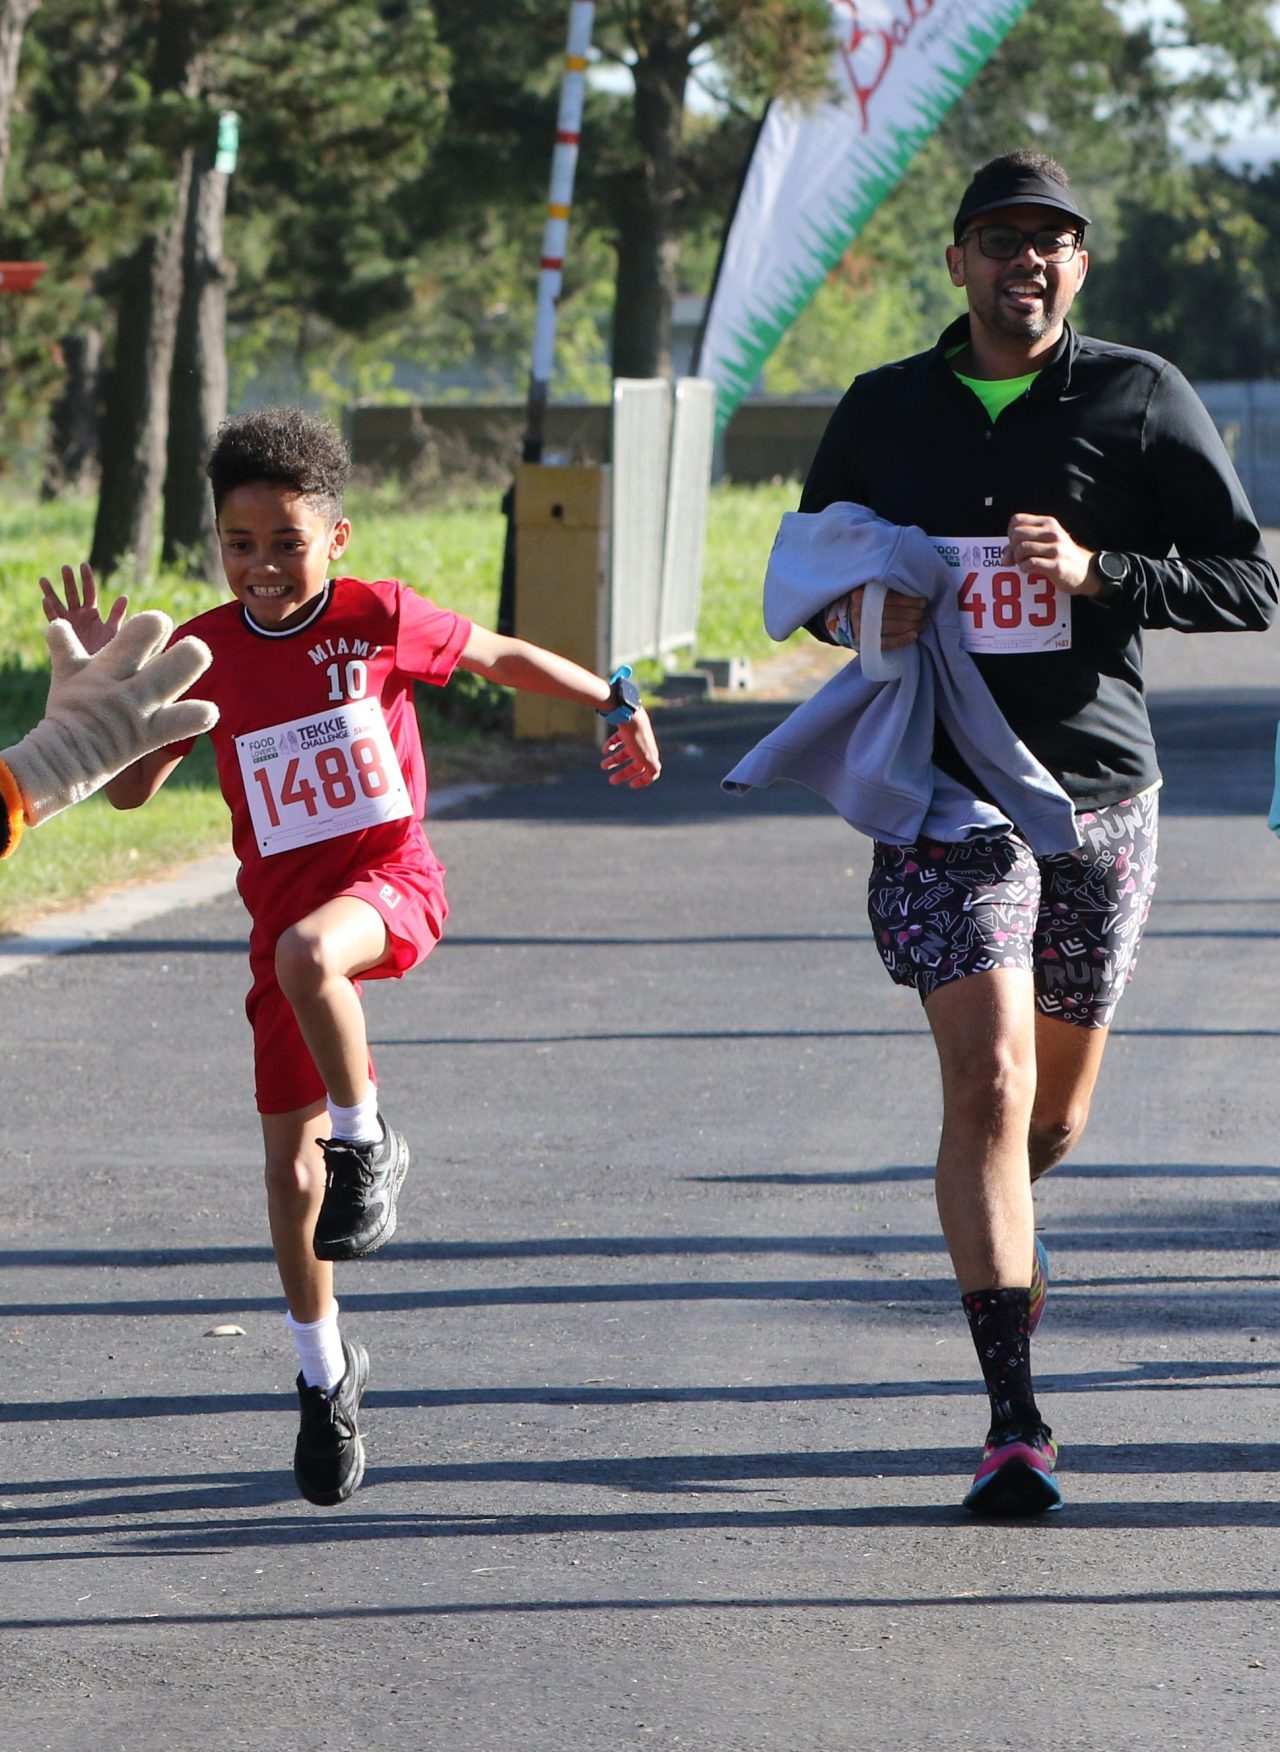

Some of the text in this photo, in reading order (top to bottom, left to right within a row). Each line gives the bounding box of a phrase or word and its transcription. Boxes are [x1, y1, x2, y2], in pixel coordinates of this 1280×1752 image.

[933, 545, 960, 555] OOD
[957, 571, 1057, 629] 483
[307, 637, 382, 666] MIAMI
[326, 660, 368, 701] 10
[297, 715, 348, 742] TEKKIE
[300, 729, 350, 751] CHALLENGE
[248, 736, 275, 751] FOOD
[253, 736, 389, 827] 1488
[1087, 804, 1144, 855] RUN
[1045, 960, 1113, 989] RUN
